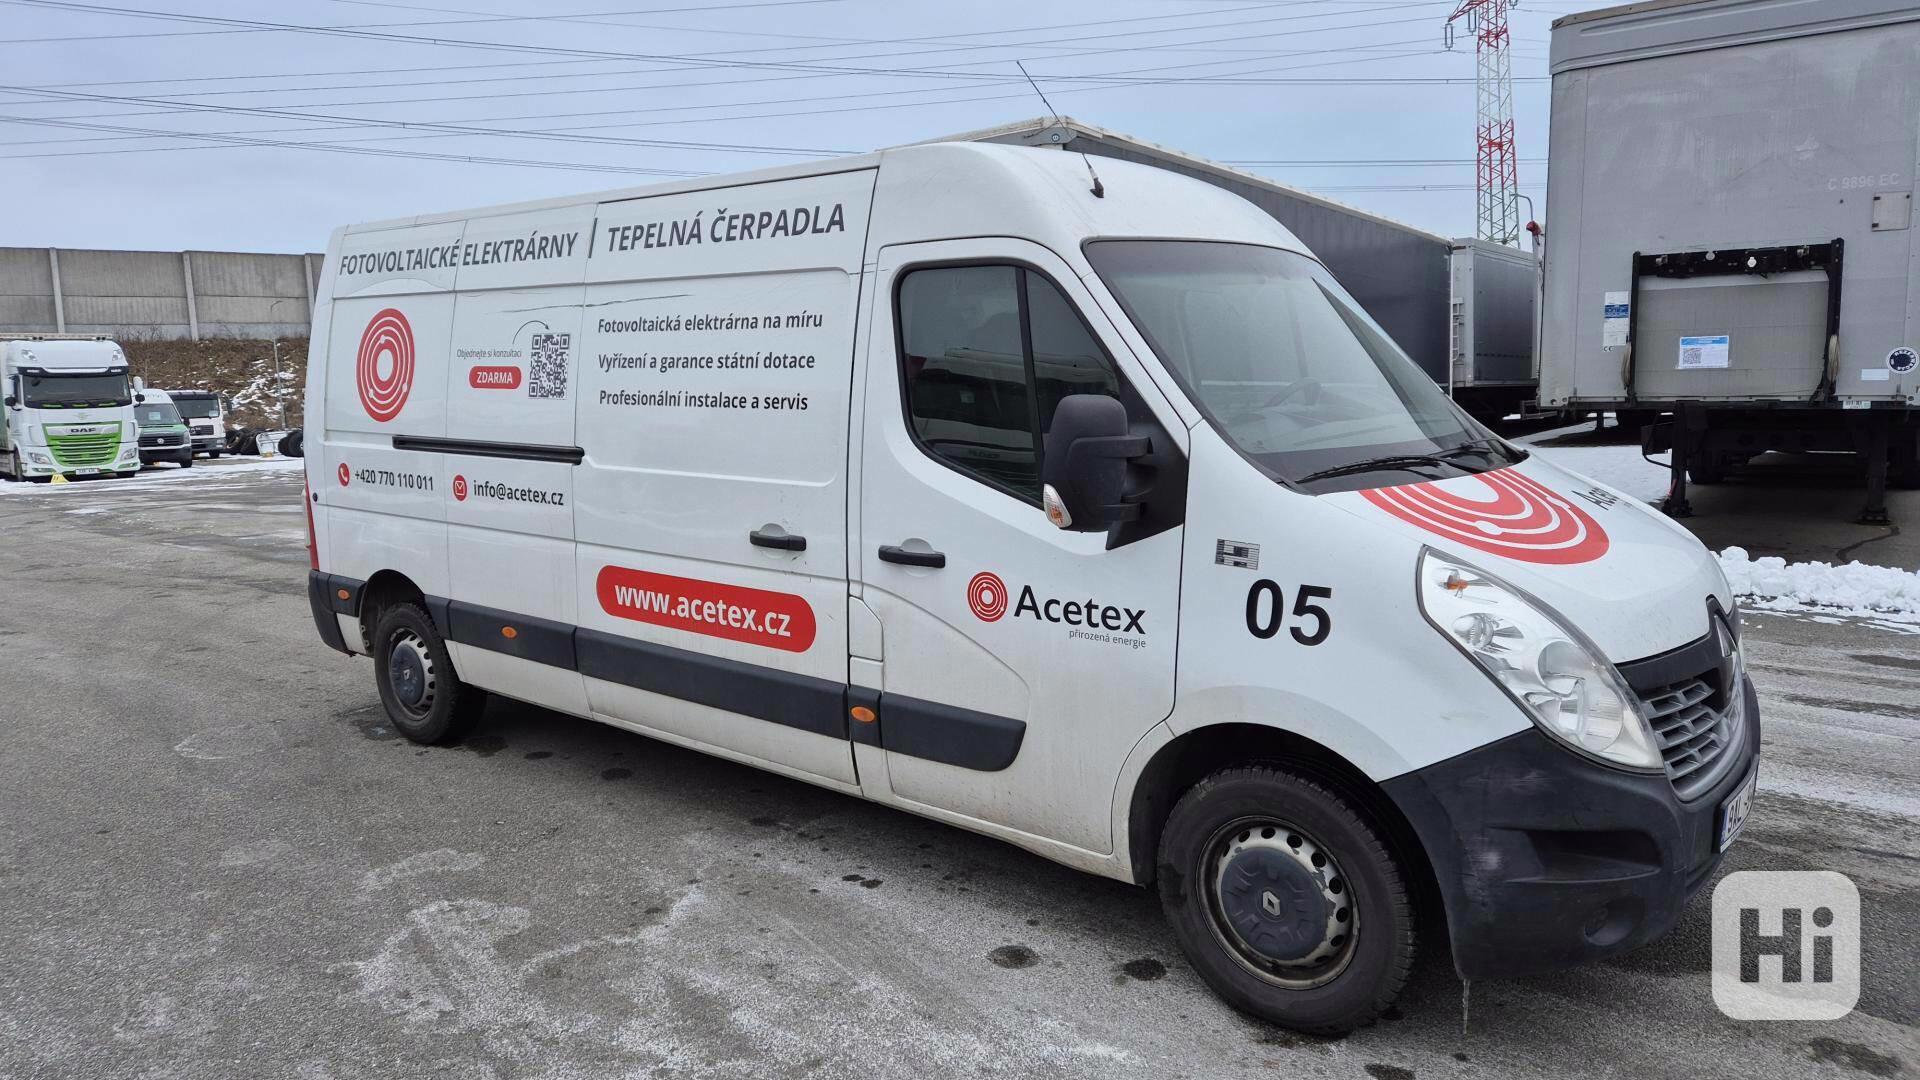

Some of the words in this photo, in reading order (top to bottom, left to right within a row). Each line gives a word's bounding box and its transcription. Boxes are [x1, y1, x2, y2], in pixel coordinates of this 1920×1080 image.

[339, 238, 461, 276] FOTOVOLTAICKÉ
[462, 230, 579, 266] ELEKTRÁRNY
[608, 210, 704, 252] TEPELNÁ
[709, 203, 846, 243] ČERPADLA
[598, 315, 681, 333] Fotovoltaická
[684, 313, 759, 331] elektrárna
[763, 315, 782, 329] na
[785, 310, 823, 328] míru
[456, 348, 487, 360] Objednejte
[487, 349, 492, 358] si
[493, 349, 522, 358] konzultaci
[598, 353, 647, 373] Vyřízení
[649, 356, 657, 369] a
[660, 355, 714, 373] garance
[716, 352, 760, 370] státní
[763, 352, 816, 369] dotace
[476, 371, 513, 384] ZDARMA
[599, 389, 681, 407] Profesionální
[684, 391, 747, 409] instalace
[751, 396, 759, 409] a
[763, 393, 808, 411] servis
[354, 469, 376, 485] +420
[377, 471, 395, 486] 770
[397, 473, 414, 489] 110
[416, 475, 434, 491] 011
[473, 479, 565, 506] info@acetex.cz
[1571, 487, 1620, 511] Ace
[614, 584, 791, 637] www.acetex.cz
[1013, 584, 1147, 635] Acetex
[1245, 578, 1333, 647] 05
[1069, 629, 1110, 645] přirozená
[1112, 633, 1147, 650] energie
